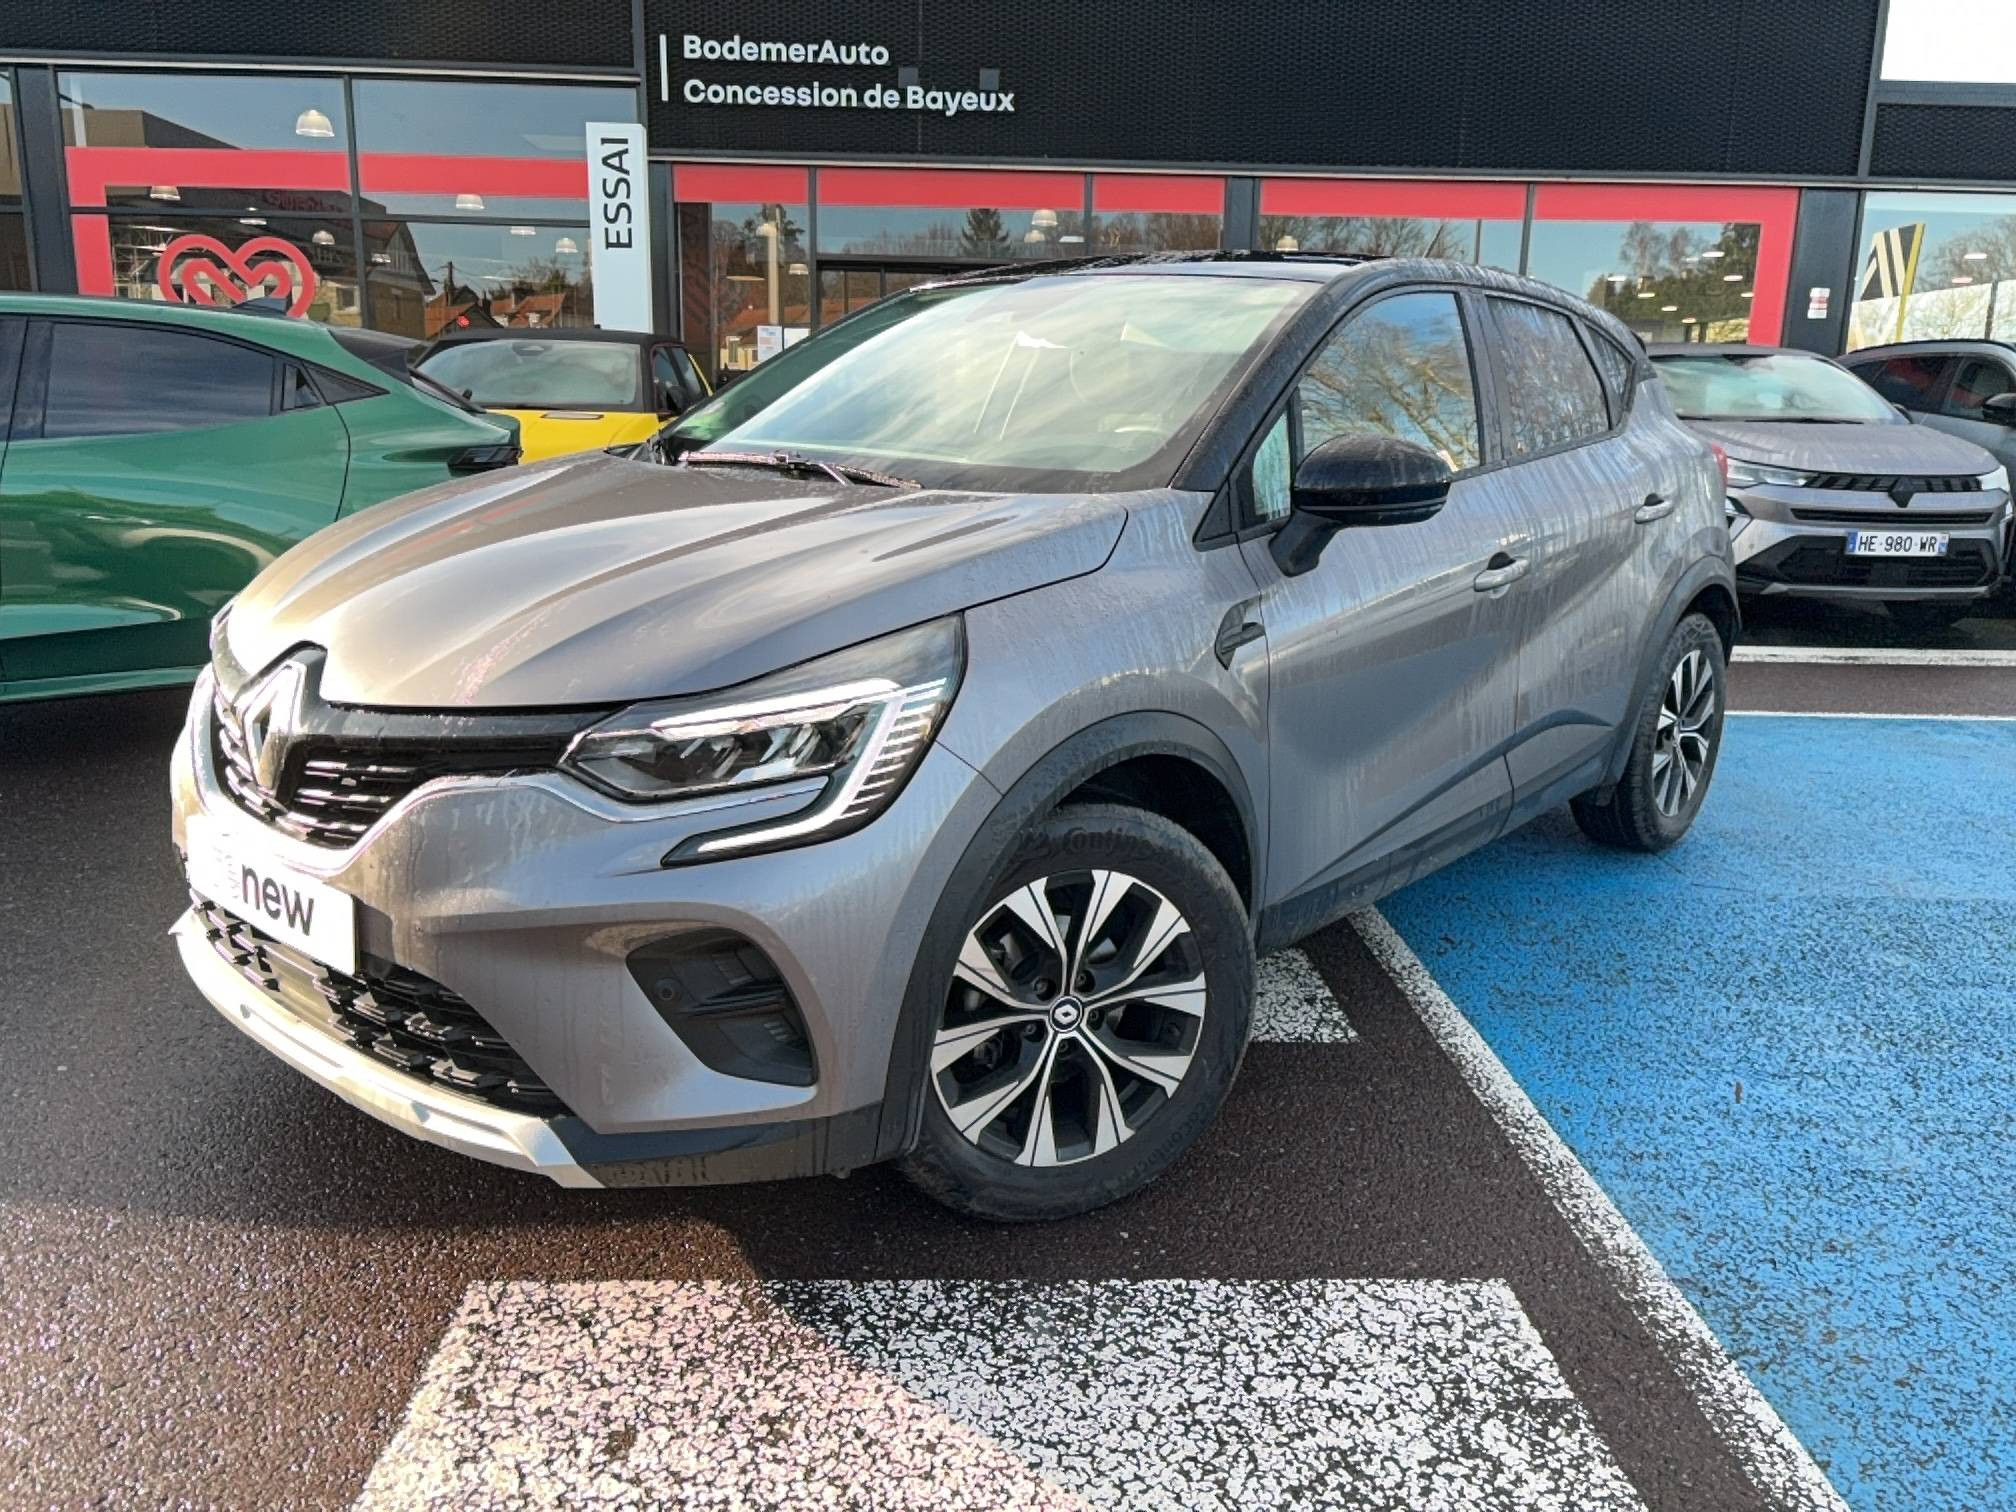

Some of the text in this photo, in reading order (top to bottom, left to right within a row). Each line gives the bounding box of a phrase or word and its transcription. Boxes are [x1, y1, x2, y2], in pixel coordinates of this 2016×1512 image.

[683, 34, 889, 65] BodemerAuto
[683, 79, 1015, 117] Concession de Bayeux
[601, 137, 633, 250] ESSAI
